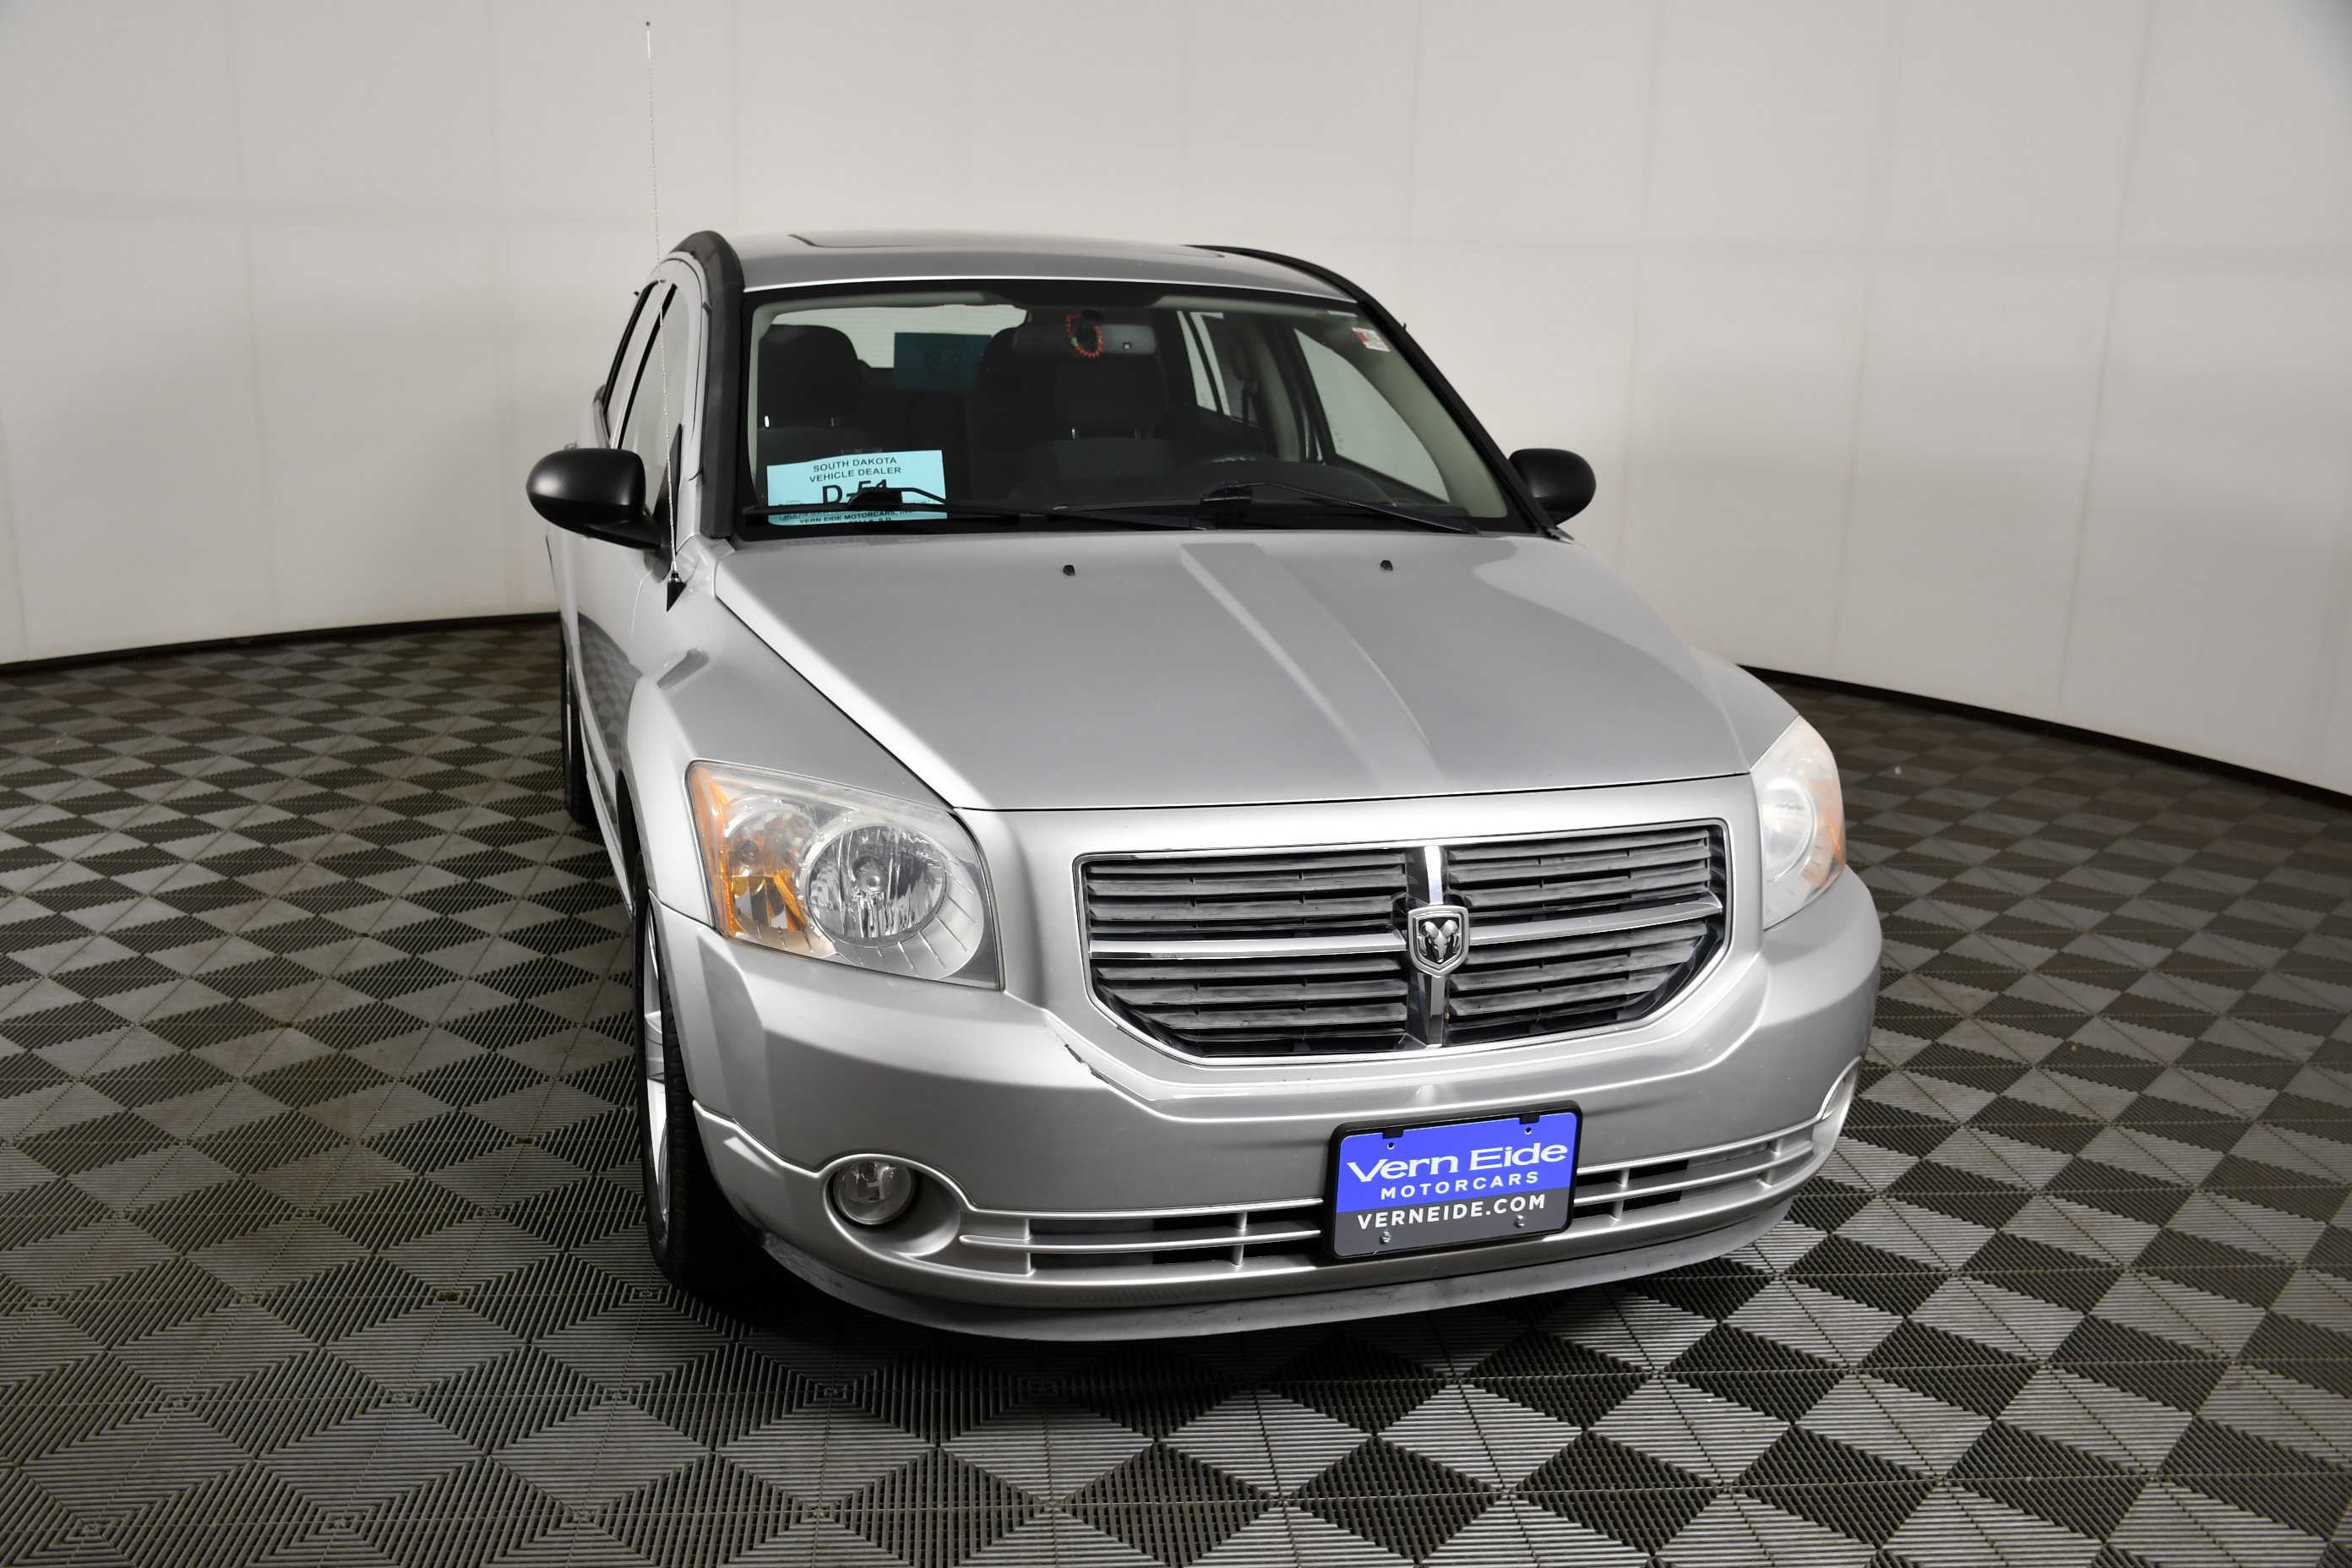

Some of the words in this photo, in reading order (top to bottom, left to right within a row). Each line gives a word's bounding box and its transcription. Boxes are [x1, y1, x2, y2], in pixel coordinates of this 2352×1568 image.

[809, 470, 855, 482] VEHICLE
[858, 466, 902, 476] DEALER
[814, 460, 849, 472] SOUTH
[852, 457, 897, 466] DAKOTA
[1346, 1156, 1458, 1182] Vern
[1469, 1143, 1568, 1171] Eide
[1380, 1171, 1538, 1200] MOTORCARS
[1357, 1194, 1546, 1230] VERNEIDE.COM
